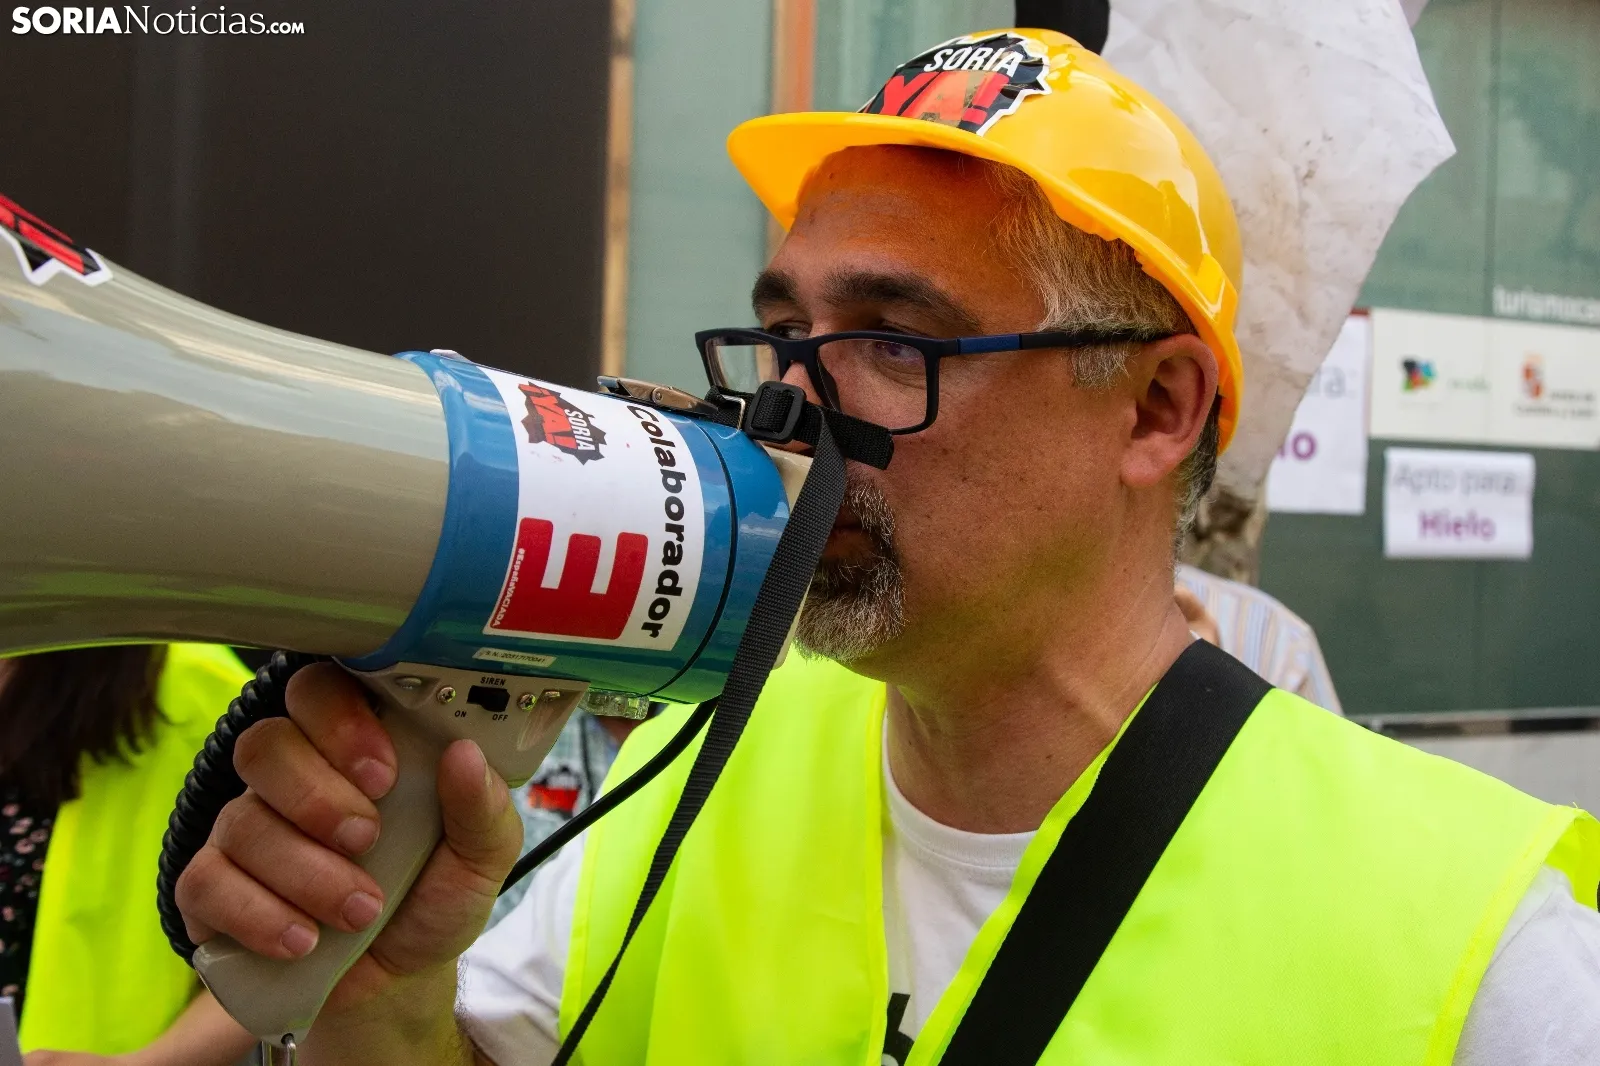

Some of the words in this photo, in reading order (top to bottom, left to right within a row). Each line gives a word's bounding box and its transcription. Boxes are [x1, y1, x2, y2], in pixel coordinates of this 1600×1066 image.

[923, 46, 1024, 78] SORIA
[865, 71, 1010, 128] YA!
[564, 408, 595, 451] SORIA
[626, 404, 687, 639] Colaborador
[1418, 510, 1496, 541] Hielo
[480, 676, 506, 686] SIREN
[454, 710, 466, 718] ON
[492, 714, 508, 722] OFF
